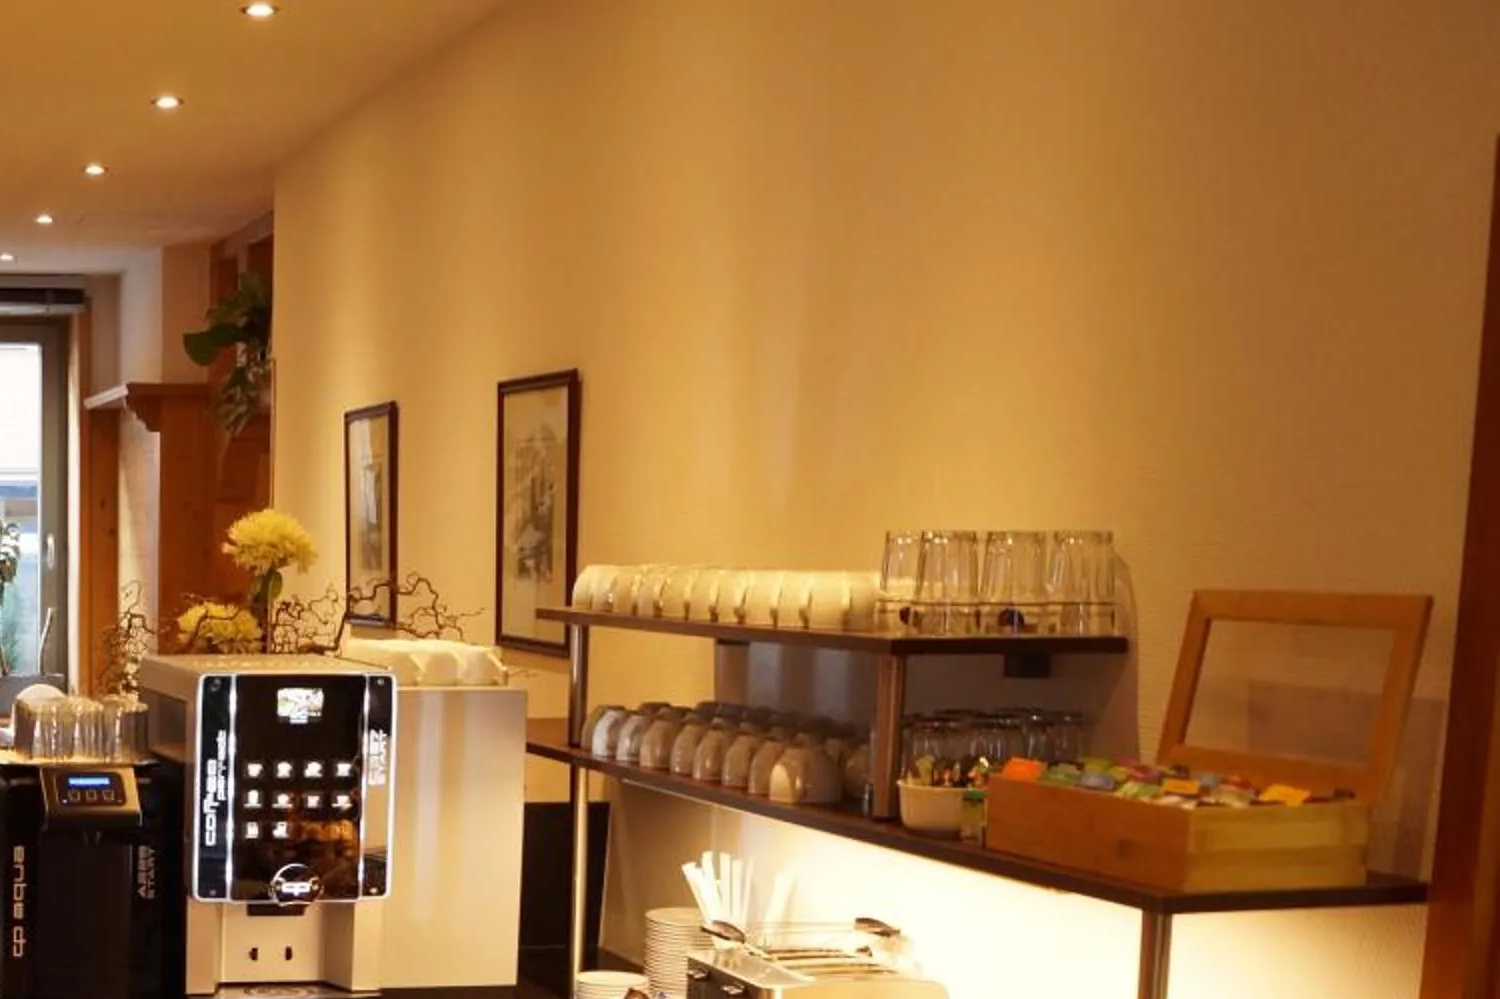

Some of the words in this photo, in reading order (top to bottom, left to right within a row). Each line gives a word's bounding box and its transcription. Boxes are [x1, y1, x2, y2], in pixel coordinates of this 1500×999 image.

[203, 758, 219, 846] coffee
[13, 845, 27, 919] aqua
[13, 925, 27, 957] cp
